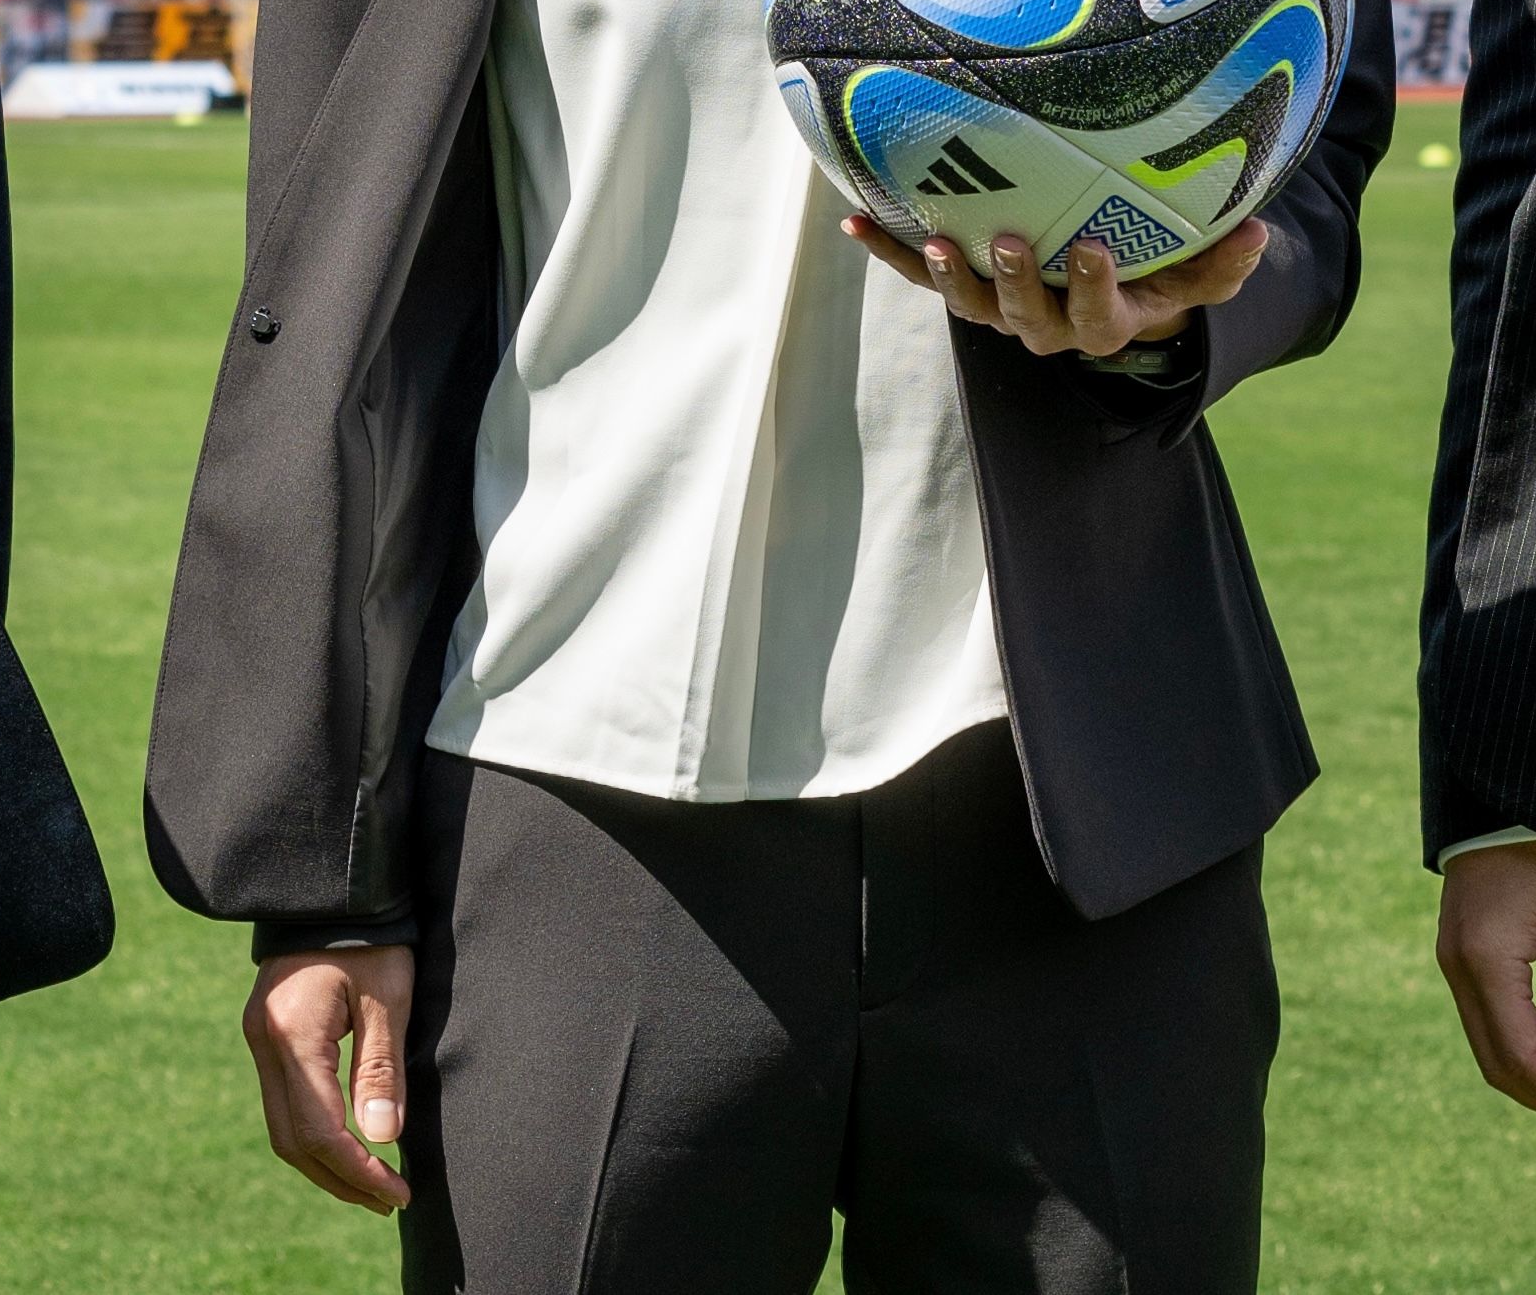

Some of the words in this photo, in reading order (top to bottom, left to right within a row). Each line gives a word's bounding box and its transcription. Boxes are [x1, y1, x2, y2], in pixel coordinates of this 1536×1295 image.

[1039, 101, 1111, 123] OFFICIAL
[1114, 92, 1160, 120] MATCH
[1161, 68, 1195, 99] BALL
